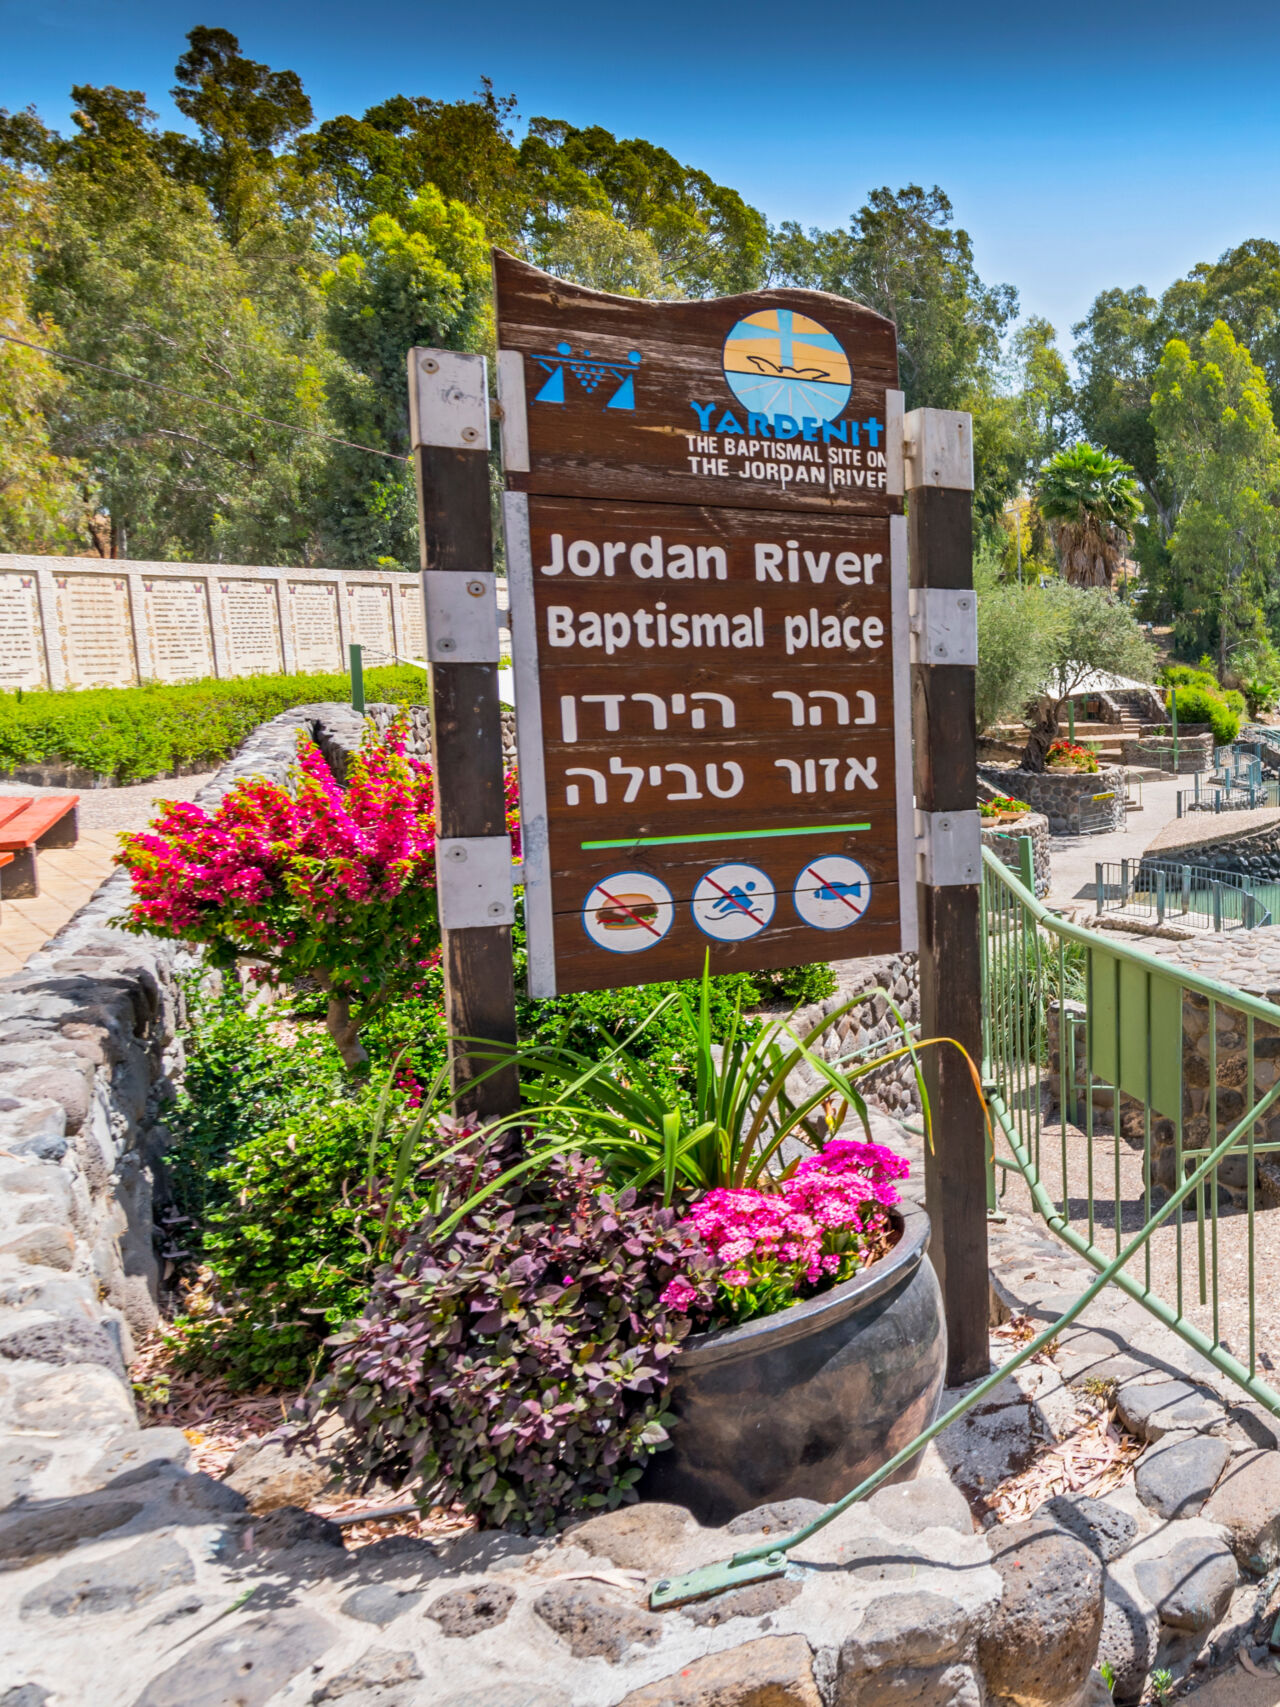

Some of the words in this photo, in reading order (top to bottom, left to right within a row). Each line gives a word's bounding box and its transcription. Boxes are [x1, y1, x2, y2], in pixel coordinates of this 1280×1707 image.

[690, 401, 884, 447] YARDENIT
[686, 435, 718, 454] THE
[724, 438, 823, 463] BAPTISMAL
[828, 447, 861, 466] SITE
[867, 451, 886, 468] ON
[687, 456, 730, 477] THE
[739, 461, 825, 484] JORDAN
[541, 533, 728, 581] Jordan
[755, 540, 883, 585] River
[547, 602, 764, 655] Baptismal
[785, 608, 884, 655] place
[561, 692, 736, 743] הירדן
[772, 690, 877, 727] נהר
[565, 756, 744, 806] טבילה
[774, 756, 879, 794] אזור
